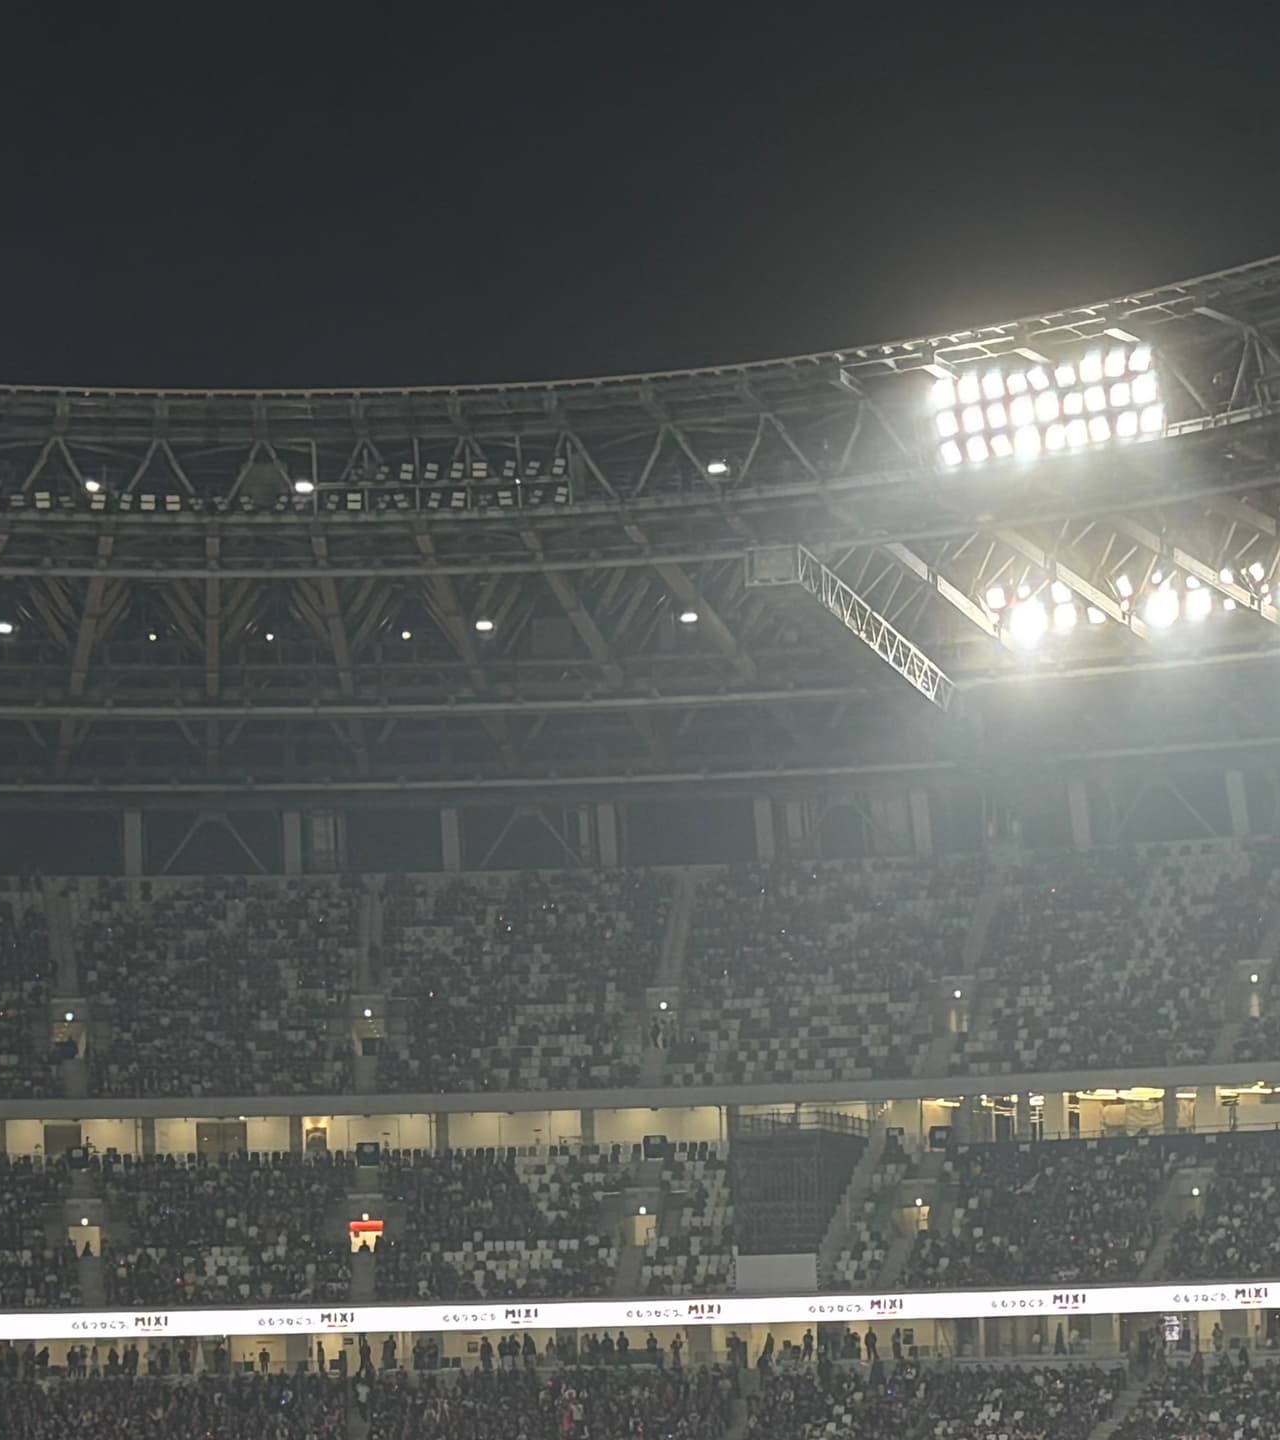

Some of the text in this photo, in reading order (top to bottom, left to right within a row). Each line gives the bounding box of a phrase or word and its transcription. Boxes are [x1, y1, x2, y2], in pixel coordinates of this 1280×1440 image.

[1235, 1287, 1267, 1299] MIXI
[871, 1299, 902, 1310] MIXI
[1053, 1293, 1085, 1305] MIXI
[506, 1308, 537, 1319] MIXI
[688, 1303, 720, 1315] MIXI
[135, 1316, 167, 1326] MIXI
[321, 1312, 353, 1323] MIXI
